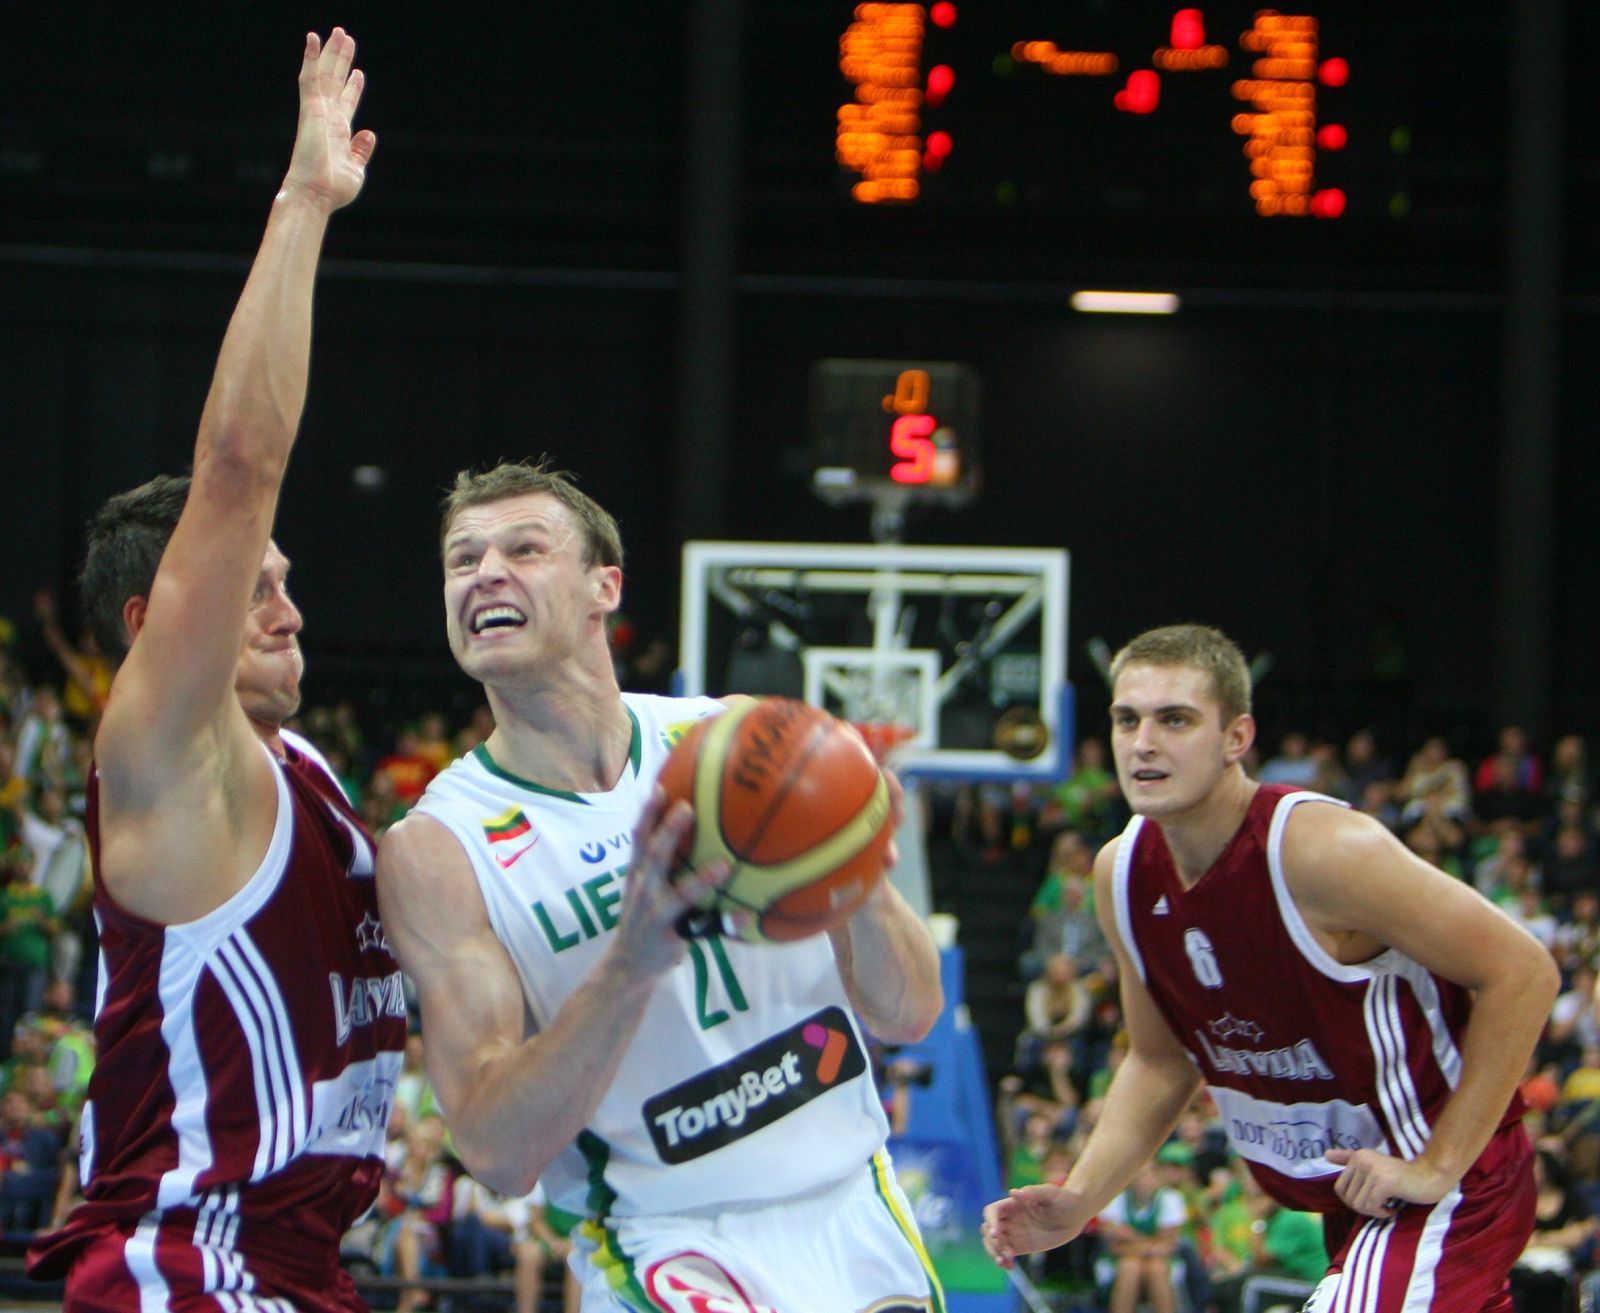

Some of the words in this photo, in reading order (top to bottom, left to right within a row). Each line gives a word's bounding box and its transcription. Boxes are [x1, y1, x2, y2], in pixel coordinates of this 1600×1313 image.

[890, 414, 937, 484] 5
[1184, 928, 1223, 988] 6
[655, 1050, 802, 1147] TonyBet
